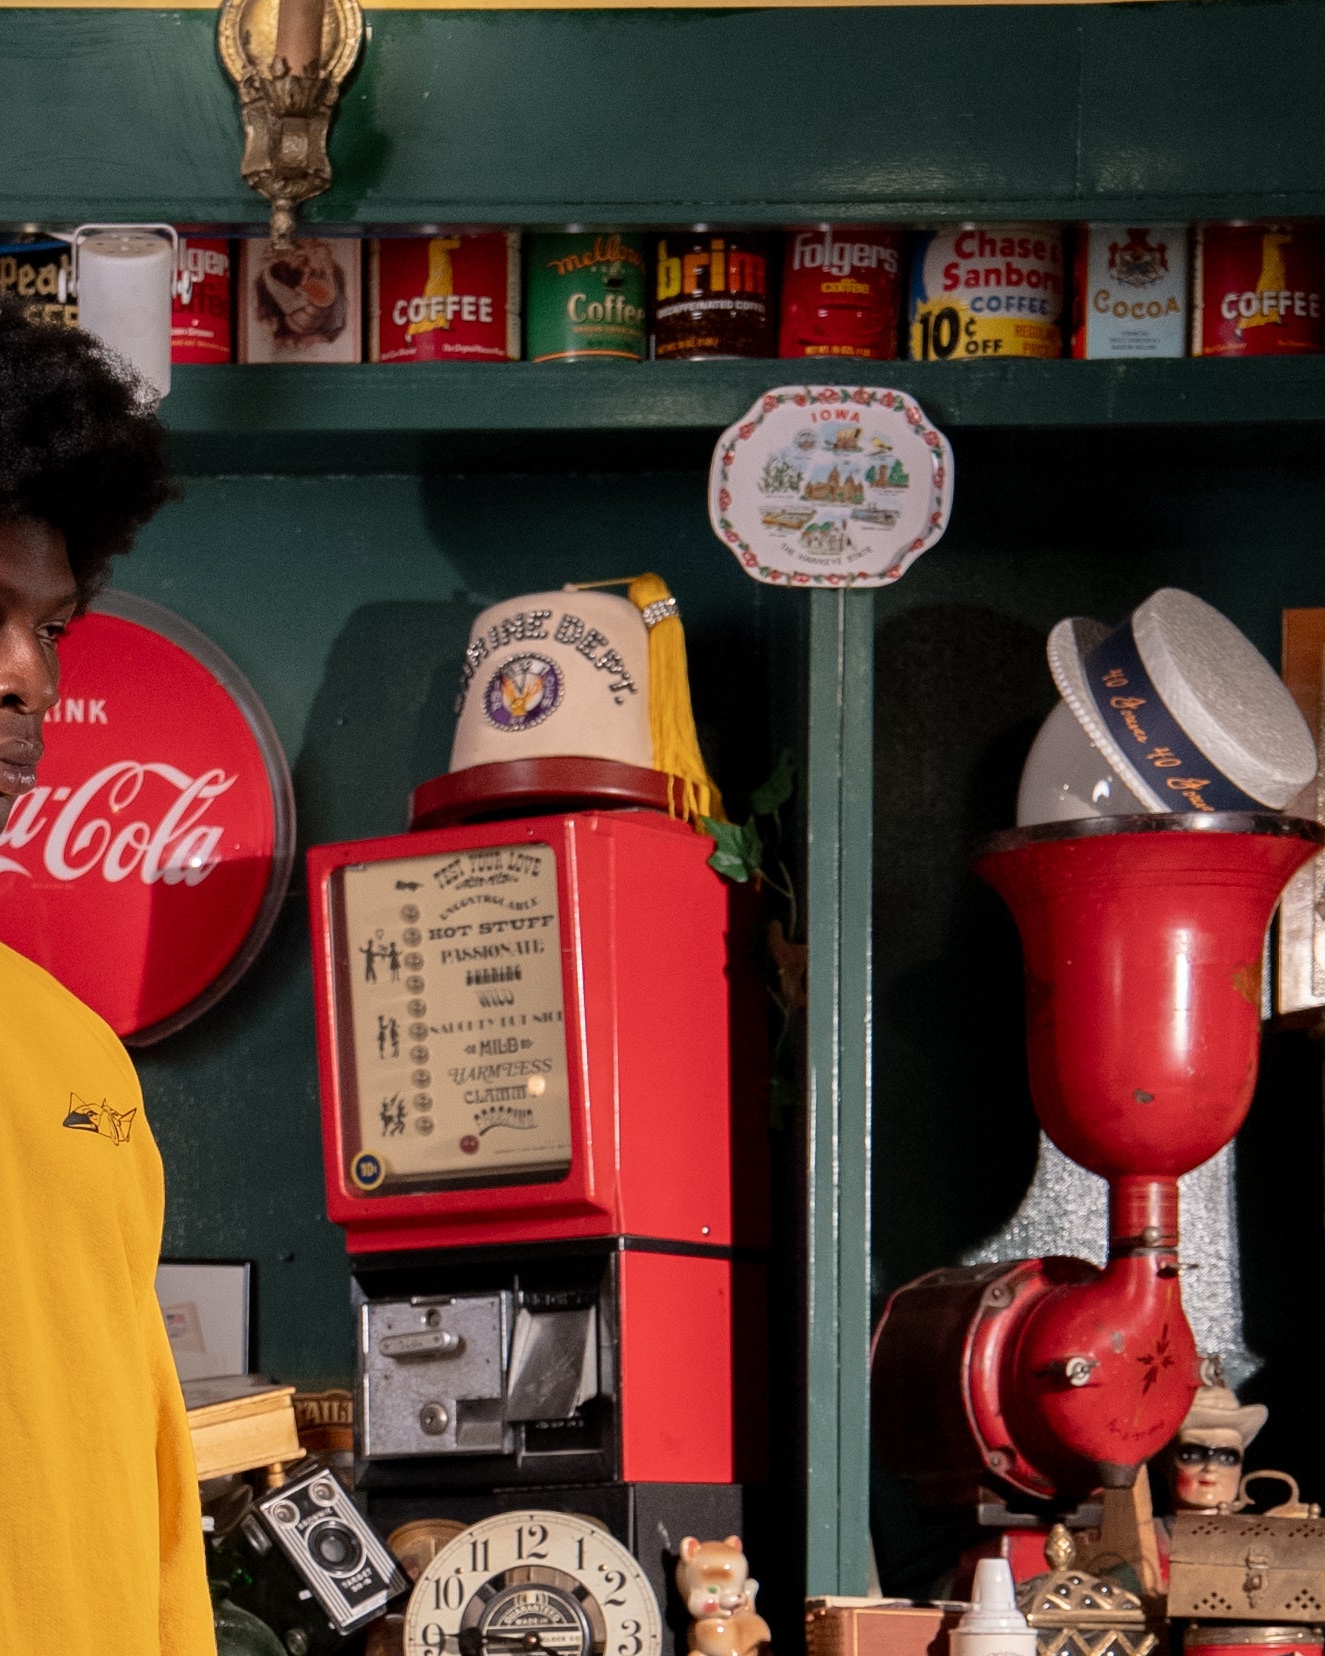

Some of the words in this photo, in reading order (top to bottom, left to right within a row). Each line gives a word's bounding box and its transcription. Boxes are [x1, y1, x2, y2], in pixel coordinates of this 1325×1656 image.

[793, 228, 898, 277] Folgers
[954, 230, 1046, 261] Chase
[657, 238, 766, 301] brim
[820, 279, 870, 294] coffee
[393, 295, 493, 325] COFFEE
[970, 296, 1048, 315] COFFEE
[1093, 288, 1182, 320] COCOA
[1220, 291, 1322, 320] COFFEE
[964, 339, 1003, 355] OFF
[812, 409, 861, 424] IOWA
[554, 613, 639, 706] DEPT.
[42, 698, 108, 724] INK
[429, 923, 473, 941] HOT
[478, 914, 555, 936] STUFF
[440, 939, 546, 965] PASSIONATE
[478, 988, 516, 1009] WILD
[500, 1014, 527, 1029] BUT
[479, 1037, 518, 1058] MILD
[448, 1058, 554, 1086] HARMLESS
[463, 1083, 539, 1105] CLAMM
[470, 1537, 491, 1573] 11
[515, 1524, 549, 1560] 12
[575, 1536, 586, 1571] 1
[433, 1573, 465, 1611] 10
[603, 1570, 627, 1607] 2
